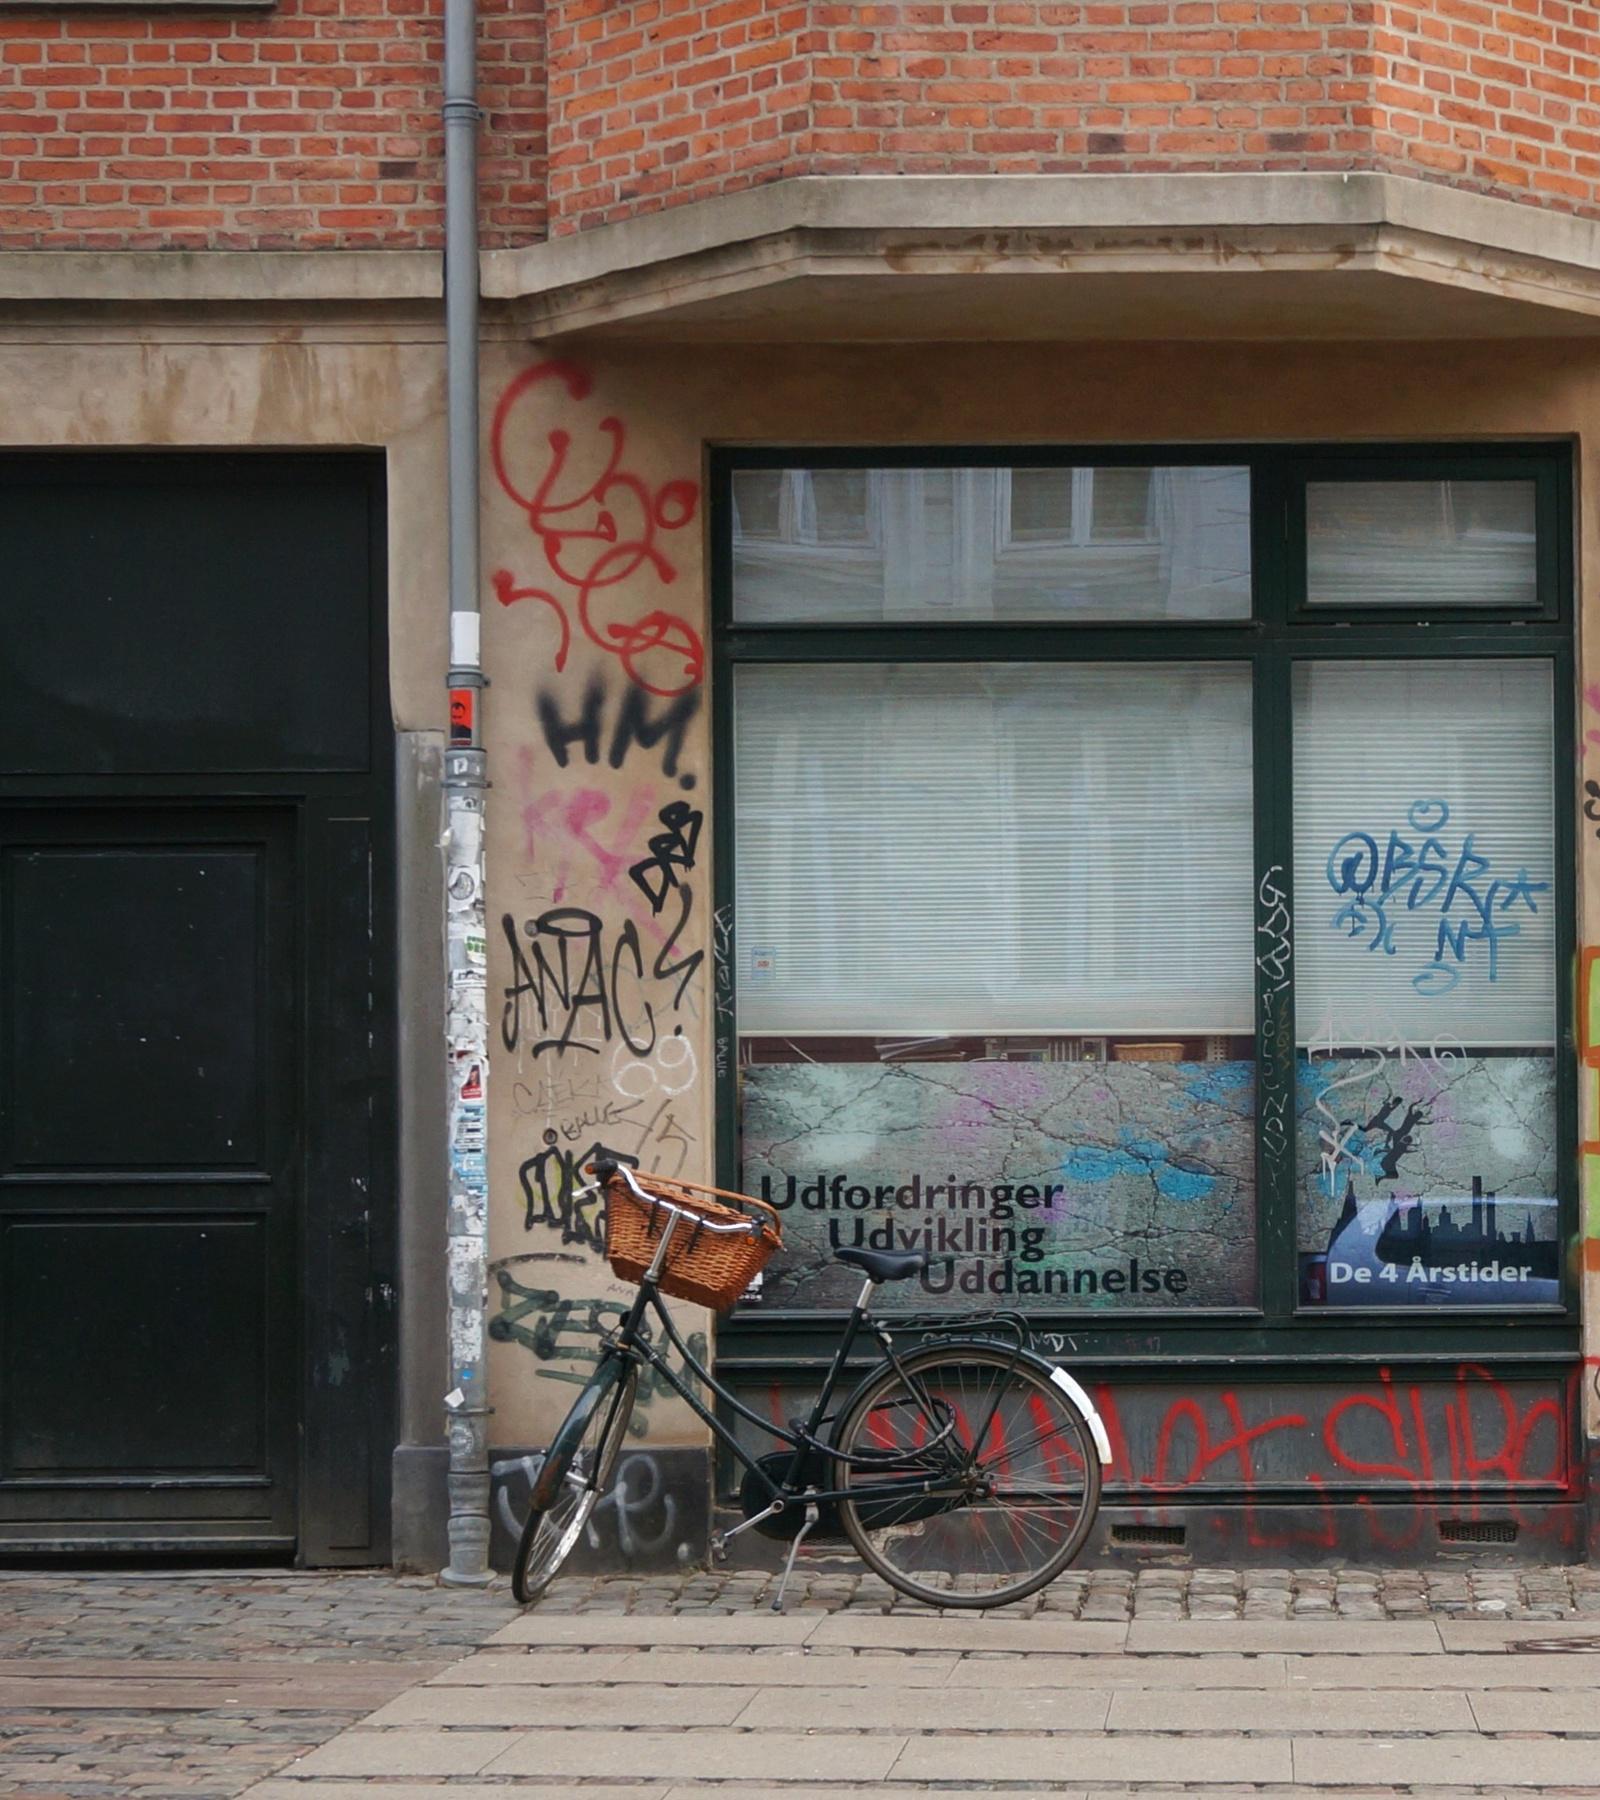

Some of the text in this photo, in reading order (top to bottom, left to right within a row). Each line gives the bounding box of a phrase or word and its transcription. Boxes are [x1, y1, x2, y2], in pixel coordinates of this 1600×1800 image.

[761, 1175, 1065, 1220] Udfordringer
[828, 1217, 1046, 1262] Udvikling
[919, 1258, 1189, 1296] Uddannelse
[1330, 1255, 1533, 1284] De 4 Årstider
